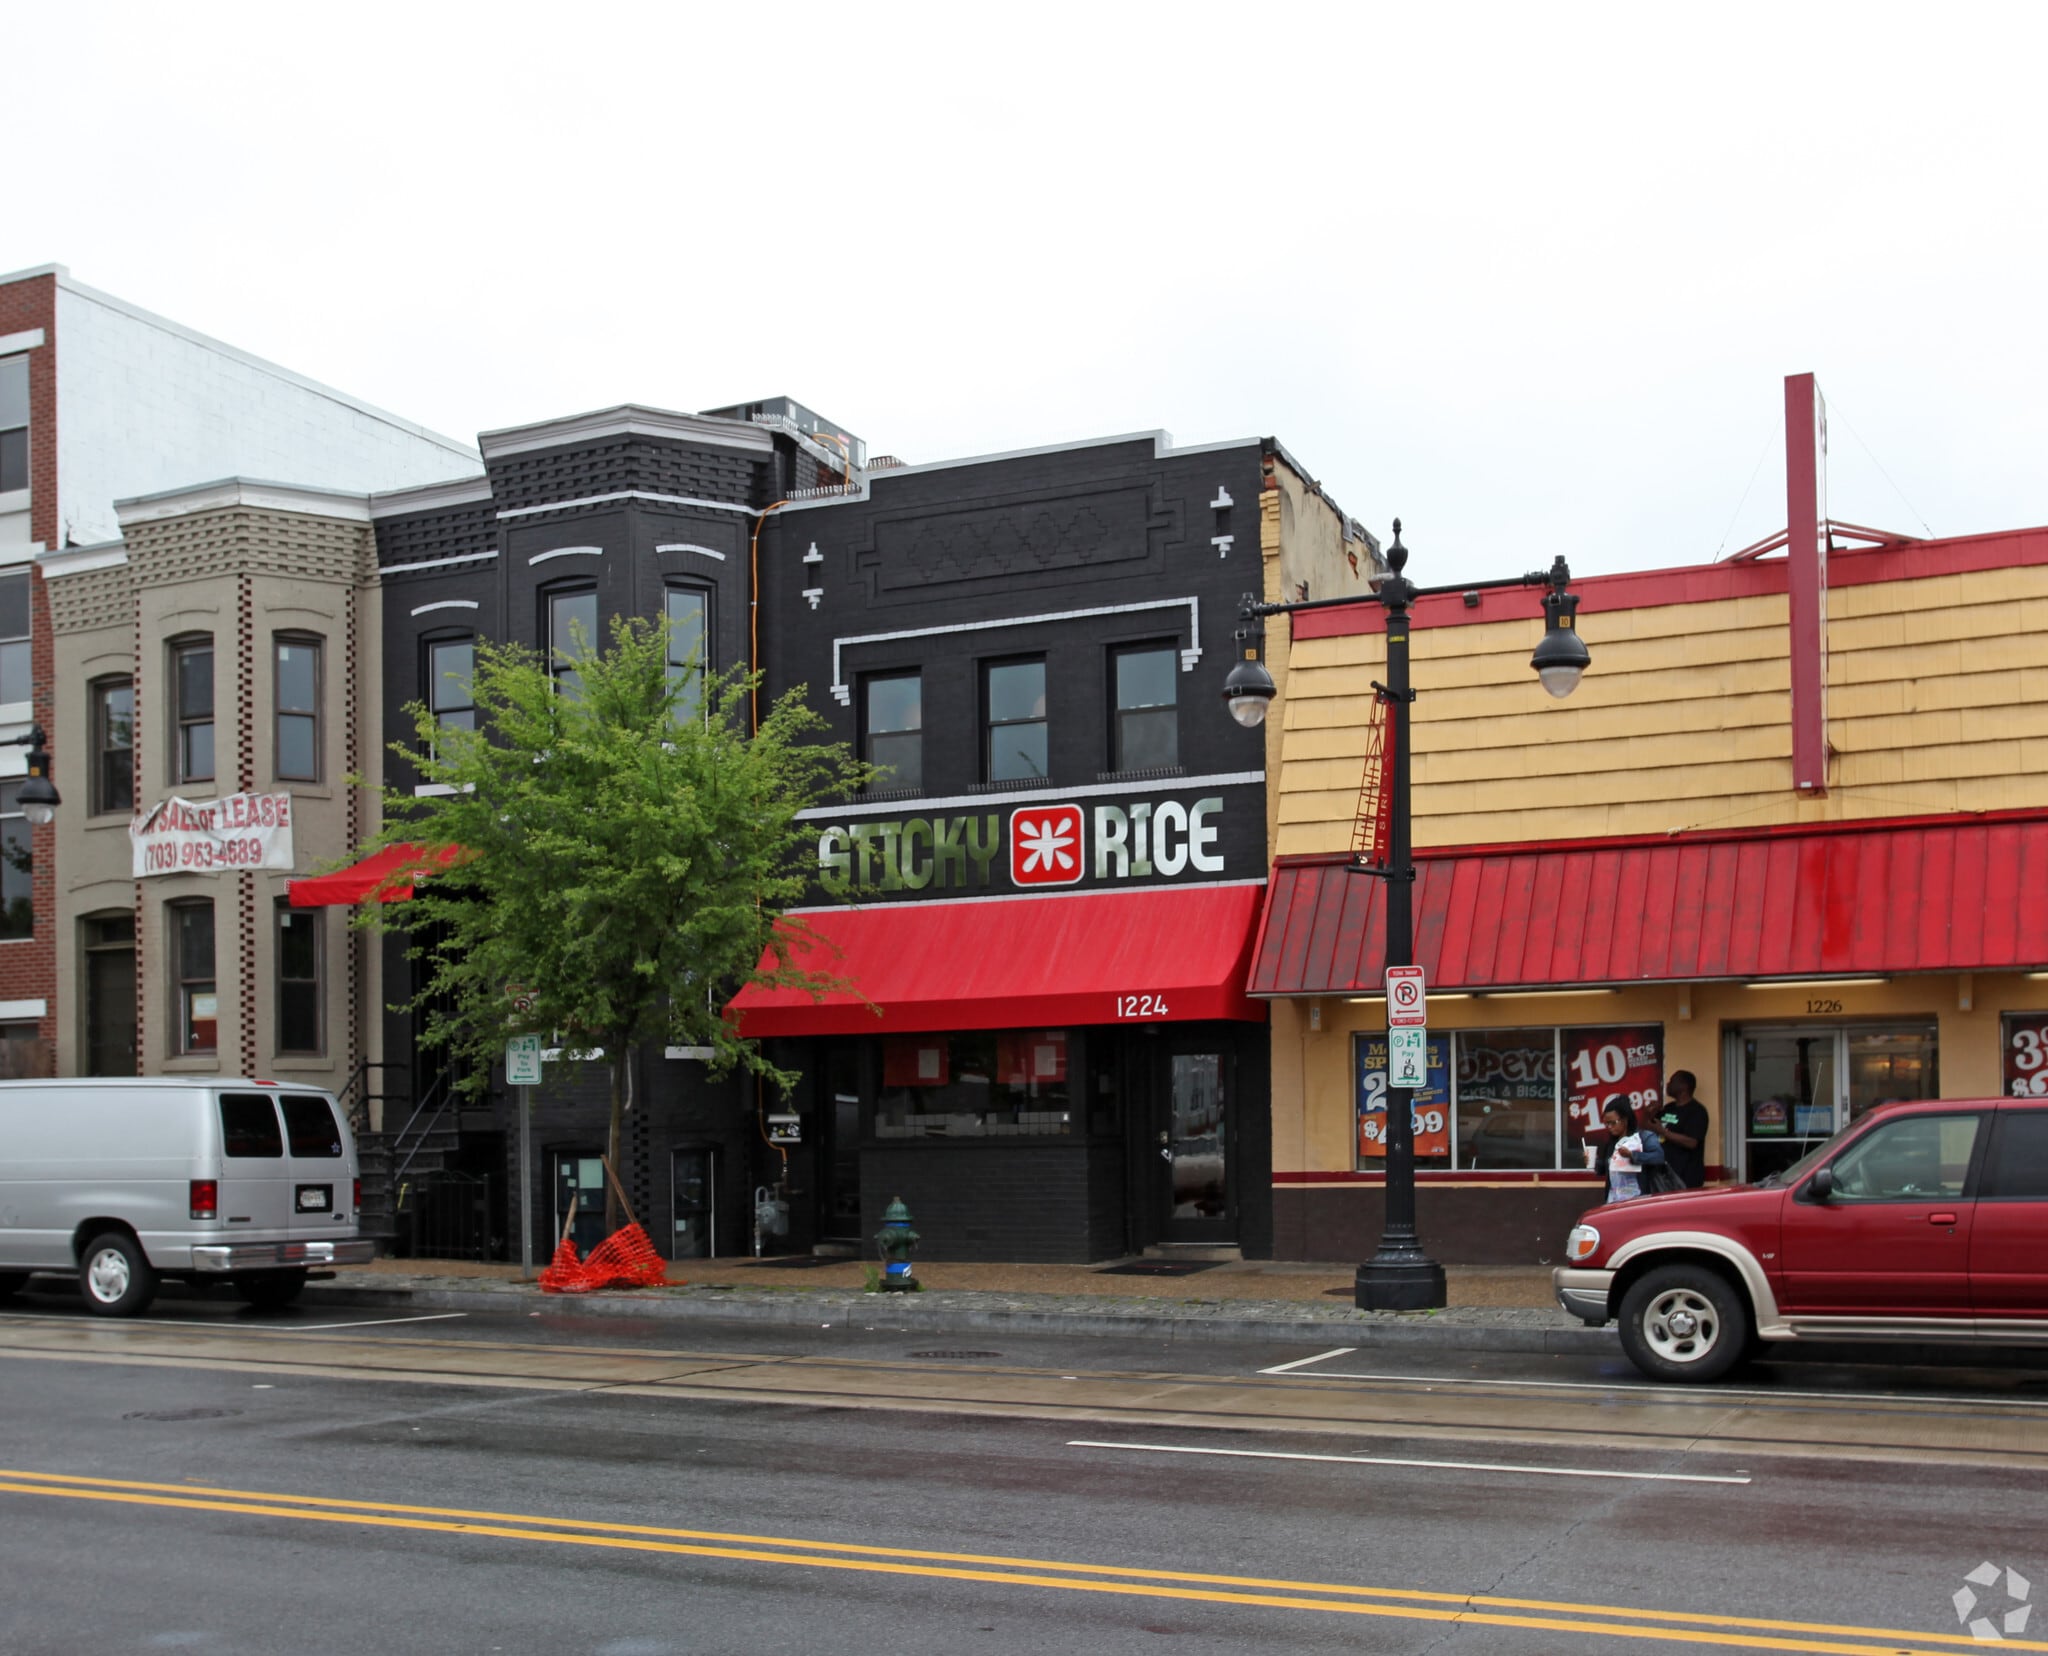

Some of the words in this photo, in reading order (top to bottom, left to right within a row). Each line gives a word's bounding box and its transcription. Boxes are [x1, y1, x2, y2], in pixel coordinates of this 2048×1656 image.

[222, 797, 289, 828] LEASE
[145, 841, 177, 872] (703)
[818, 814, 1000, 892] STICKY
[1095, 797, 1224, 879] RICE
[1118, 994, 1168, 1017] 1224
[1806, 1000, 1842, 1014] 1226
[1402, 1050, 1415, 1058] Pay
[1571, 1044, 1626, 1088] 10
[1626, 1043, 1655, 1059] PCS
